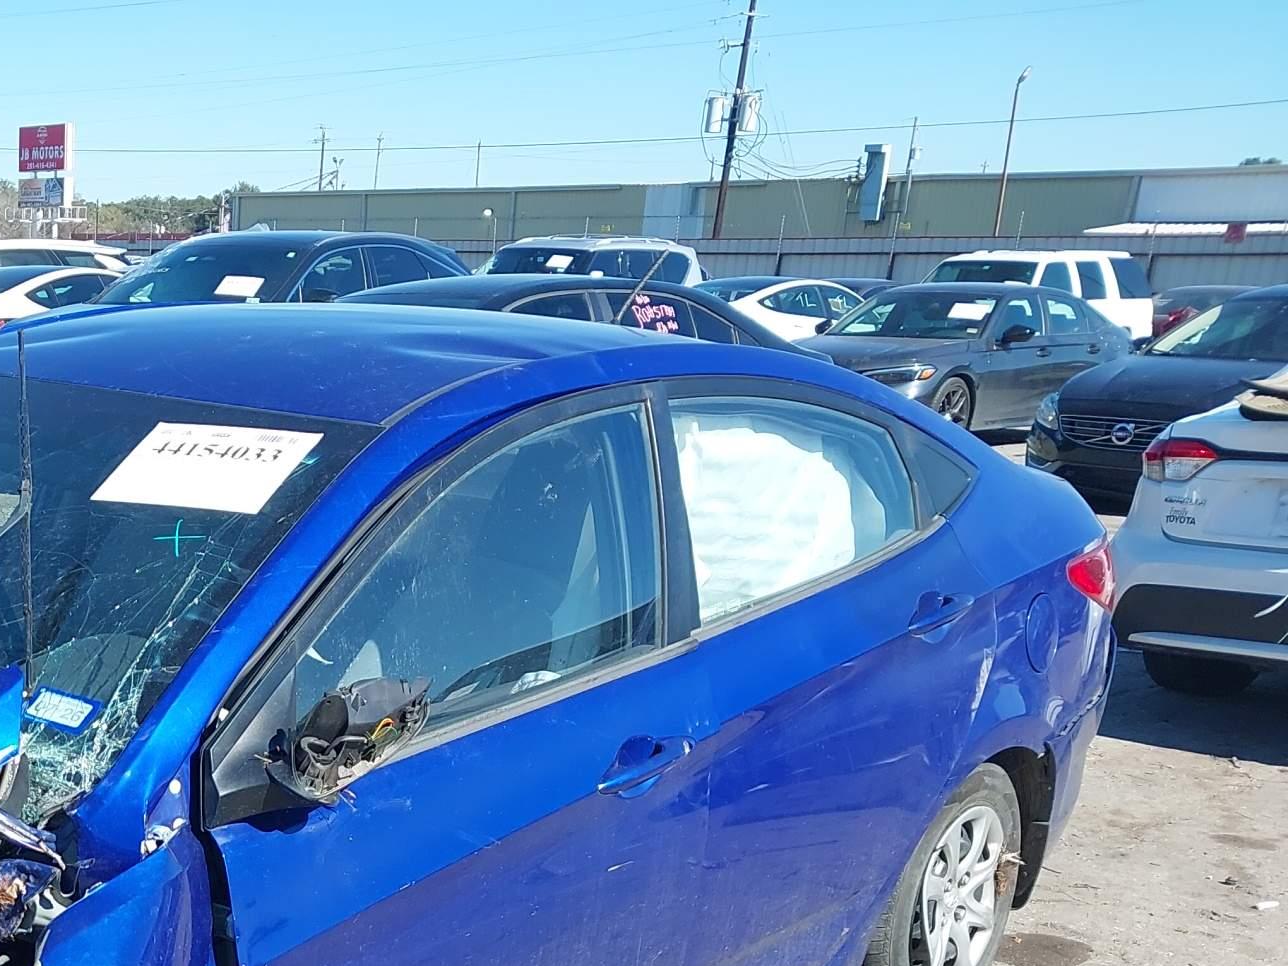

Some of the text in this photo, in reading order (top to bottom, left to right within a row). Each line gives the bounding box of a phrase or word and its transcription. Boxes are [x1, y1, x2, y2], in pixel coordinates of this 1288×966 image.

[20, 145, 64, 161] JB MOTORS
[152, 441, 283, 463] 44154033
[1166, 514, 1196, 526] TOYOTA
